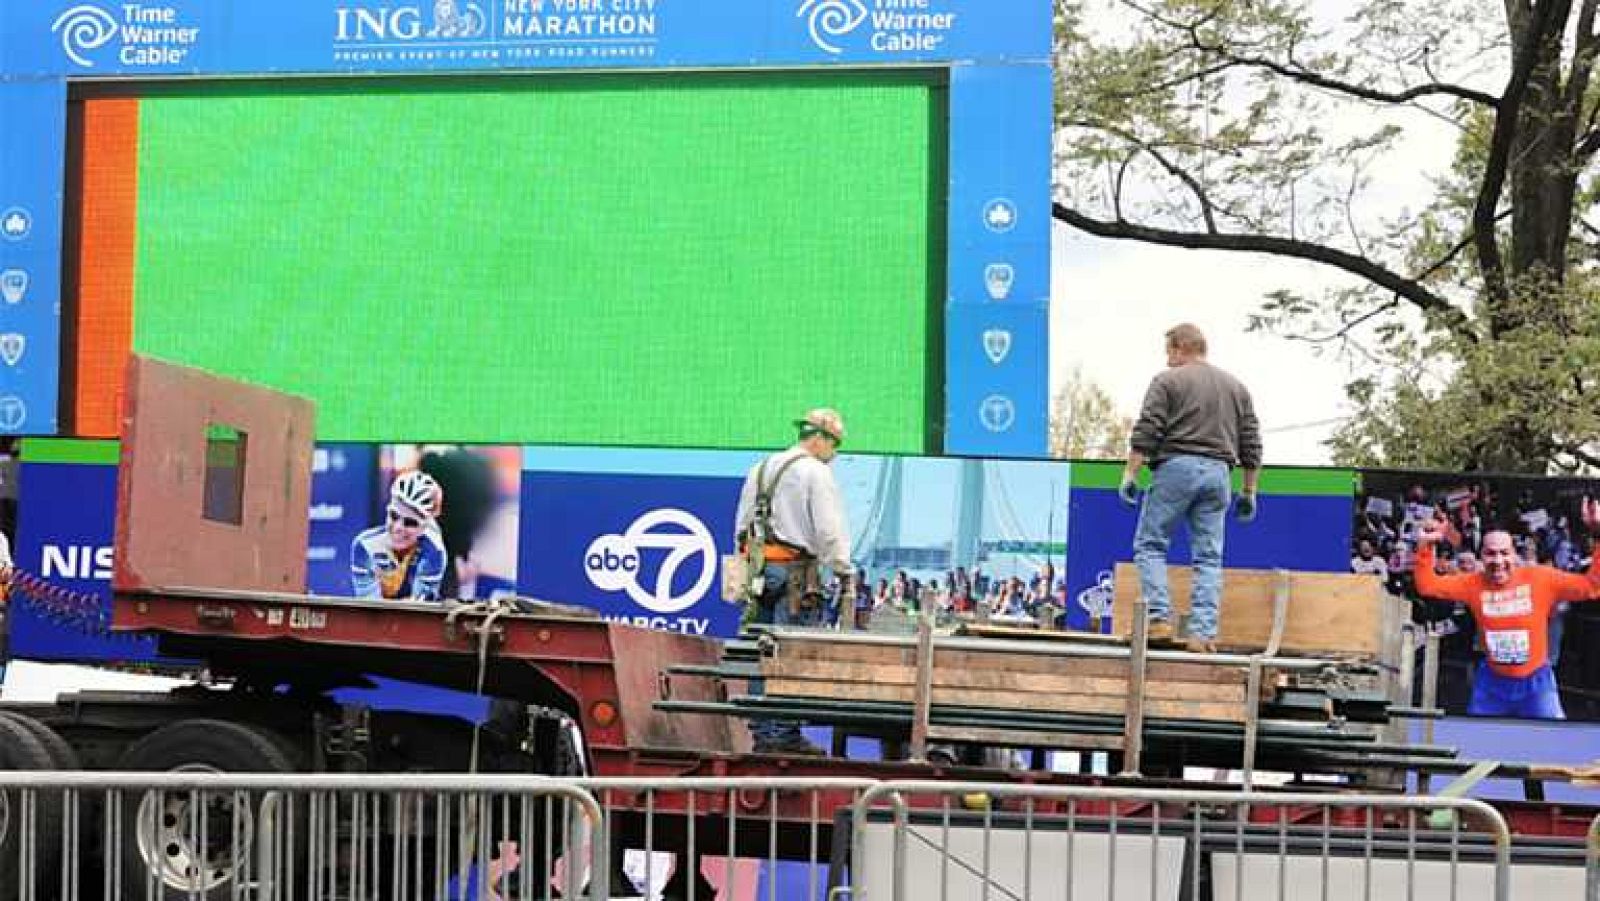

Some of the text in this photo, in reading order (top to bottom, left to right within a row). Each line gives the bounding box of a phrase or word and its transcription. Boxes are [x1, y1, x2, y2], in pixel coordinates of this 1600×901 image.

[122, 3, 175, 23] Time
[504, 0, 655, 12] NEW YORK CITY
[335, 8, 422, 41] ING
[504, 15, 655, 36] MARATHON
[872, 10, 957, 30] Warner
[122, 25, 200, 44] Warner
[871, 32, 937, 51] Cable
[120, 46, 181, 65] Cable
[334, 51, 394, 61] PREMIER
[41, 545, 114, 579] NIS
[587, 532, 708, 602] abc 7
